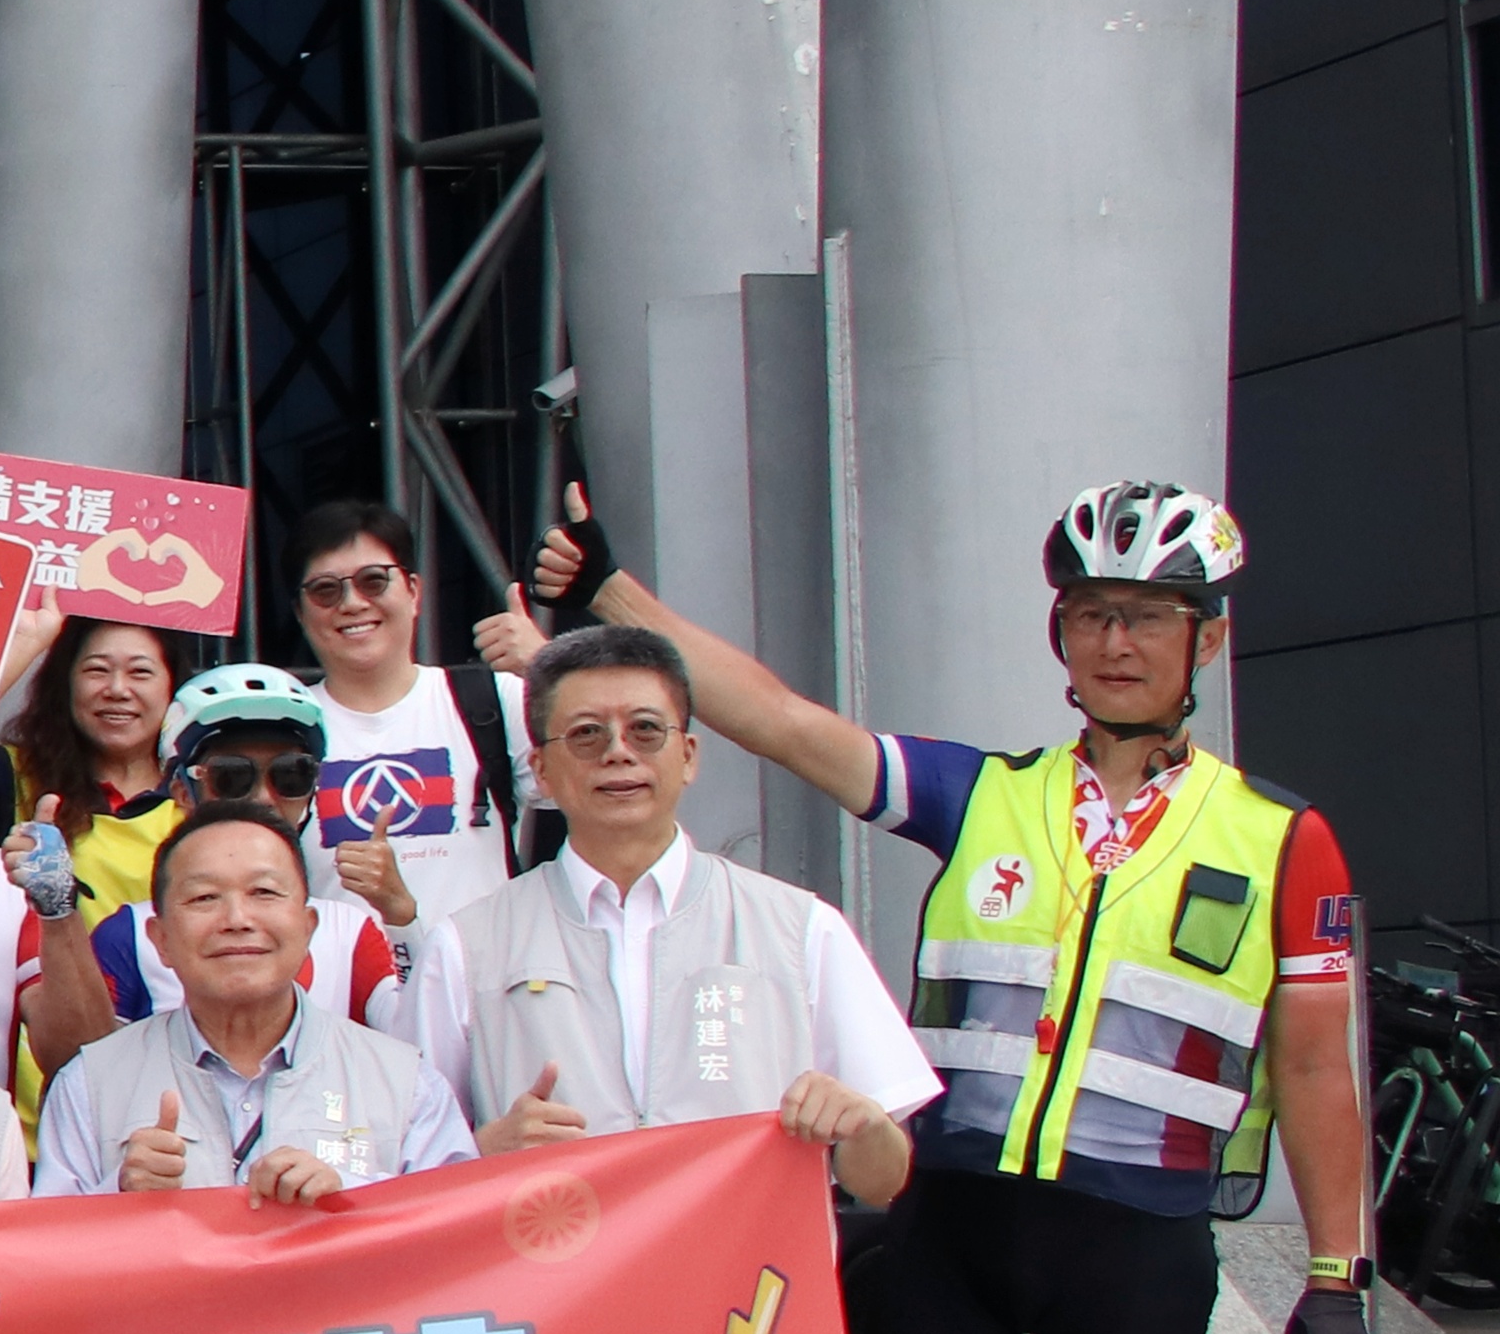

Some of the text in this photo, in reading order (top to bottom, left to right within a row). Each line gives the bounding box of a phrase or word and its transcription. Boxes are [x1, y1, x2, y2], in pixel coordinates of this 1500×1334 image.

[401, 847, 449, 862] good life
[694, 985, 729, 1081] 林建宏
